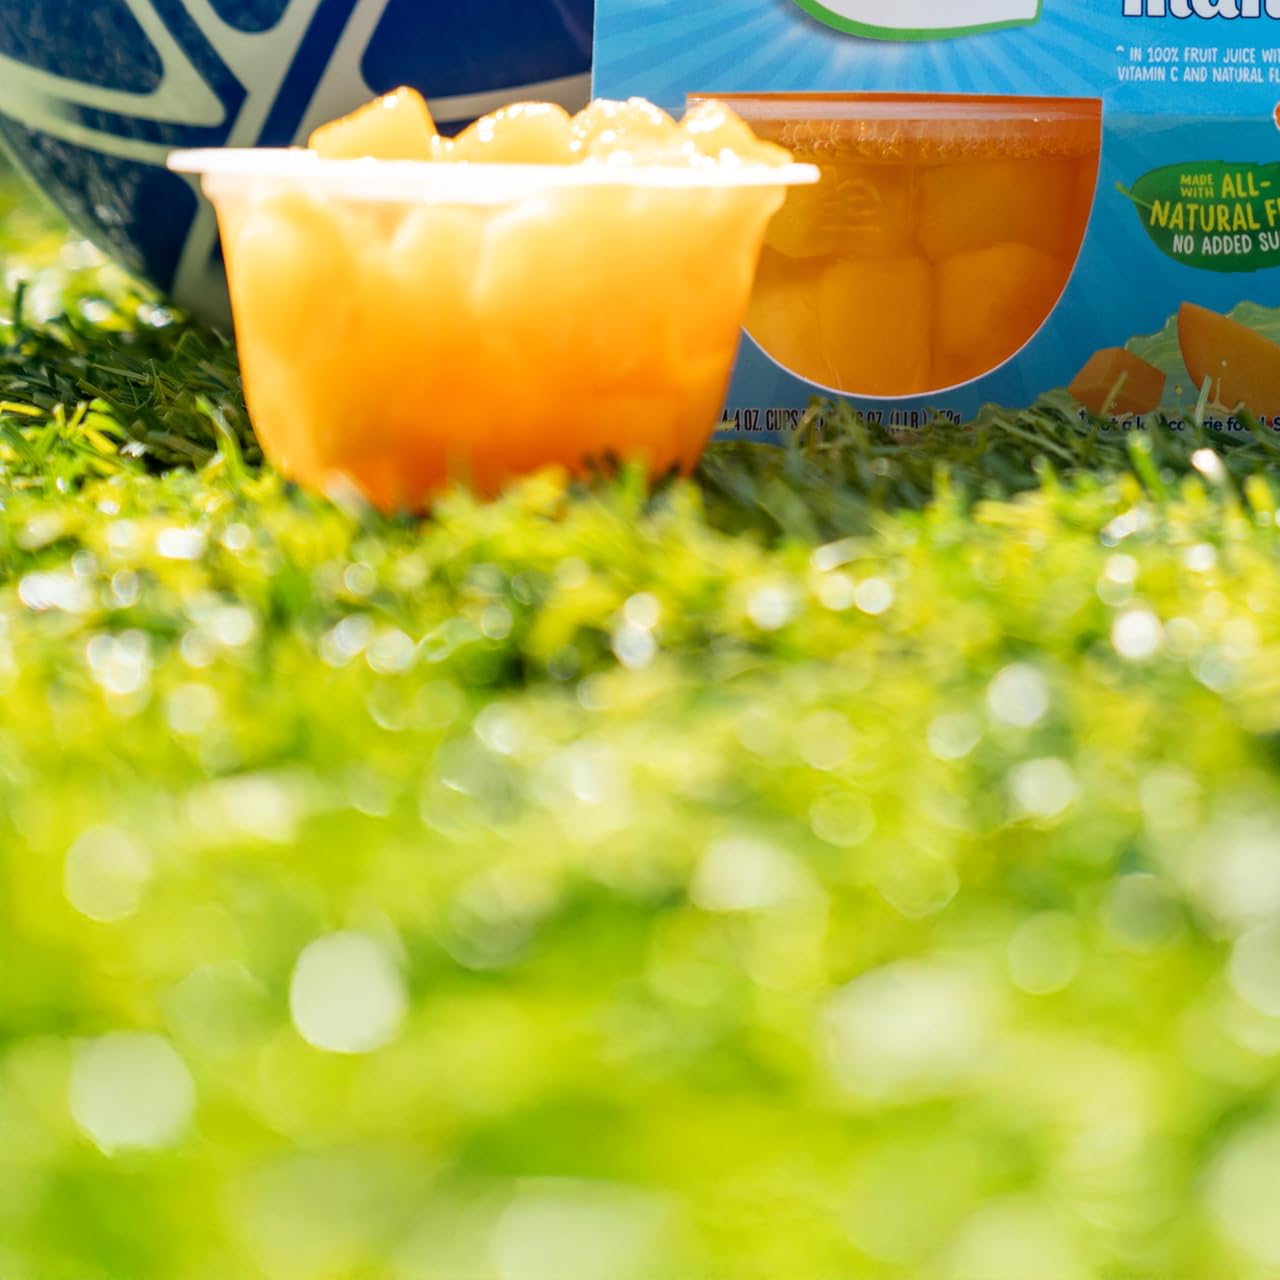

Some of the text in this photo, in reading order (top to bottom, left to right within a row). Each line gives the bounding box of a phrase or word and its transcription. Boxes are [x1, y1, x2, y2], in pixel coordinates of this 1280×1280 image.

[1130, 47, 1142, 62] IN
[1147, 47, 1179, 63] 100%
[1184, 47, 1218, 63] FRUIT
[1223, 47, 1256, 63] JUICE
[1117, 66, 1166, 81] VITAMIN
[1170, 66, 1179, 82] C
[1183, 67, 1207, 82] AND
[1212, 67, 1264, 83] NATURAL
[1180, 173, 1214, 186] MADE
[1221, 172, 1271, 199] ALL-
[1180, 186, 1214, 199] WITH
[1151, 200, 1260, 232] NATURAL
[1172, 234, 1194, 255] NO
[1201, 234, 1252, 255] ADDED
[743, 408, 763, 432] OZ.
[765, 408, 799, 432] CUPS
